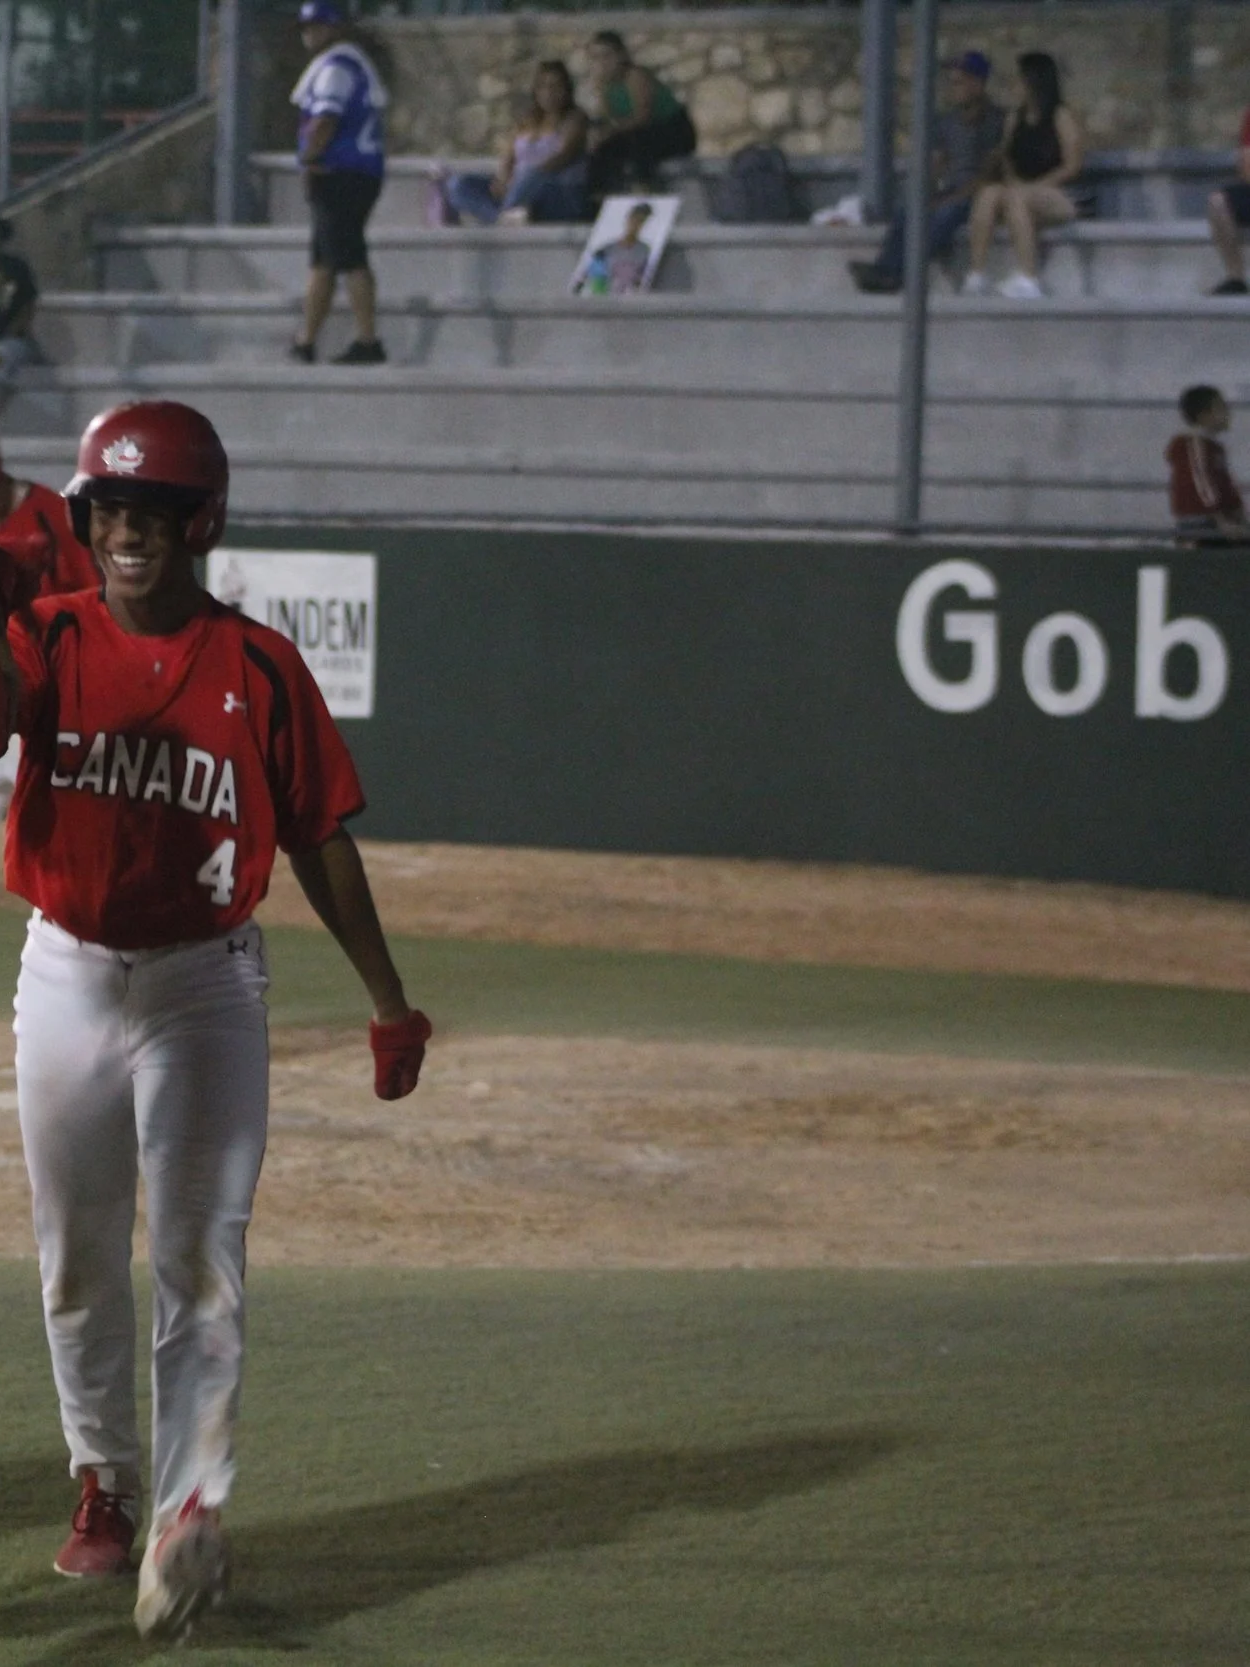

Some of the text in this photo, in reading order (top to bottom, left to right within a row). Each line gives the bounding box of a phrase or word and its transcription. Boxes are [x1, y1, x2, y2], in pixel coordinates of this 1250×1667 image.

[895, 558, 1230, 722] Gob
[50, 731, 238, 826] CANADA
[196, 838, 236, 907] 4
